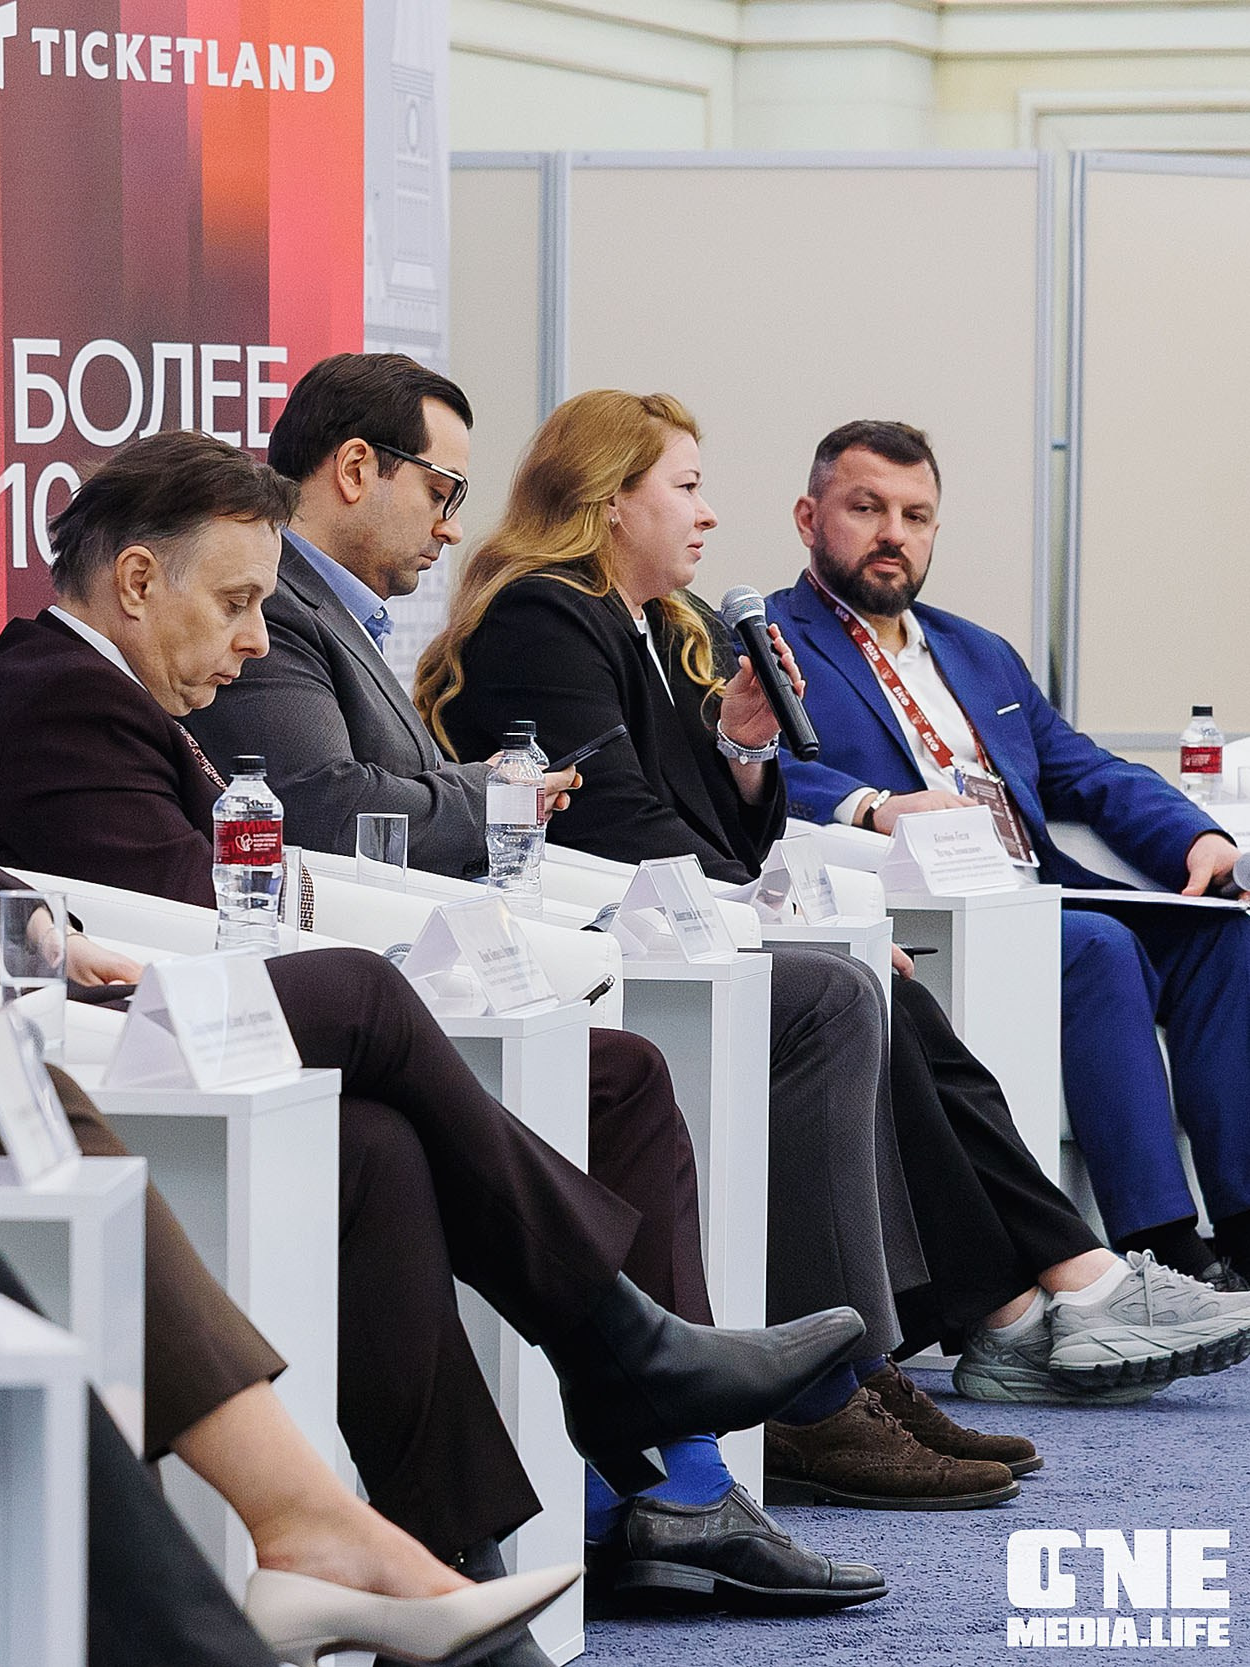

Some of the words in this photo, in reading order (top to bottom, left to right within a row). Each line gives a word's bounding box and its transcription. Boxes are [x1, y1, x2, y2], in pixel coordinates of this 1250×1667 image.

[31, 27, 336, 93] TICKETLAND
[12, 337, 289, 448] БОЛЕЕ
[862, 641, 880, 662] 2026
